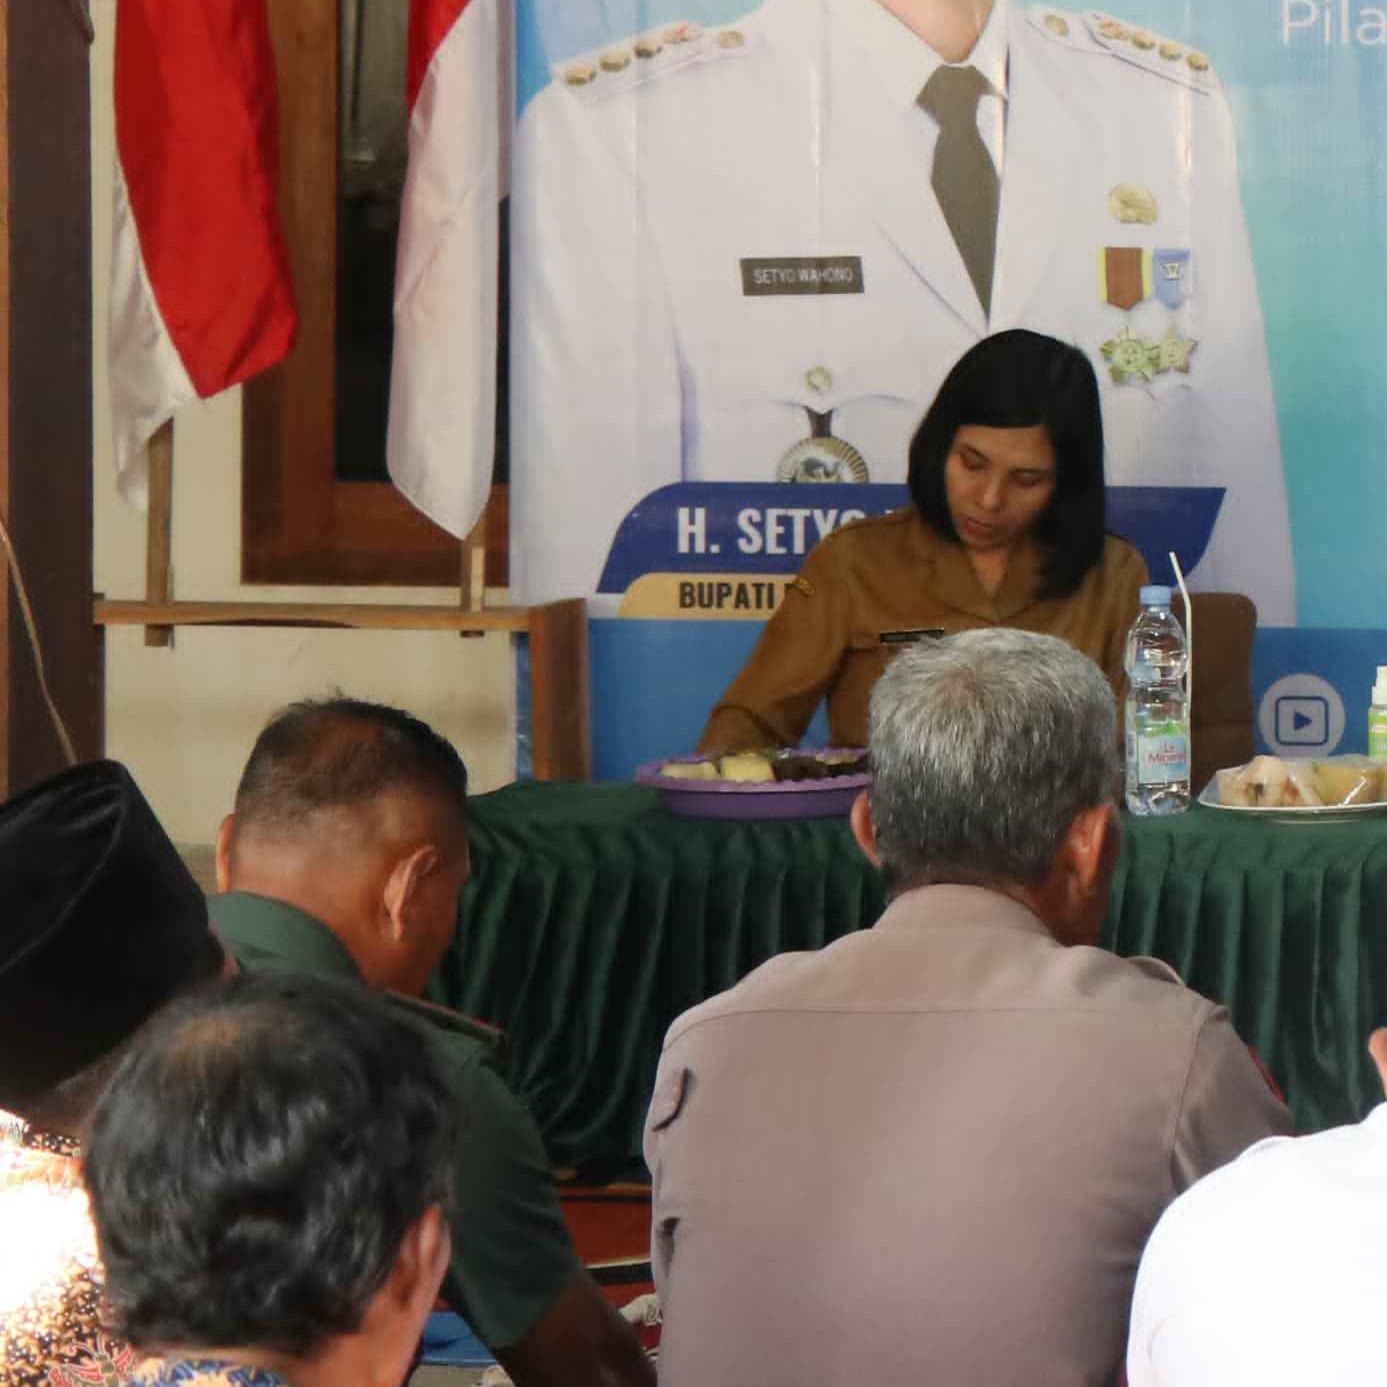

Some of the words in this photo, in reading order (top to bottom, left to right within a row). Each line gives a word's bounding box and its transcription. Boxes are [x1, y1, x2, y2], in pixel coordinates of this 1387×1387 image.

[753, 268, 797, 285] SETYO
[677, 508, 720, 554] H.
[679, 581, 775, 609] BUPATI
